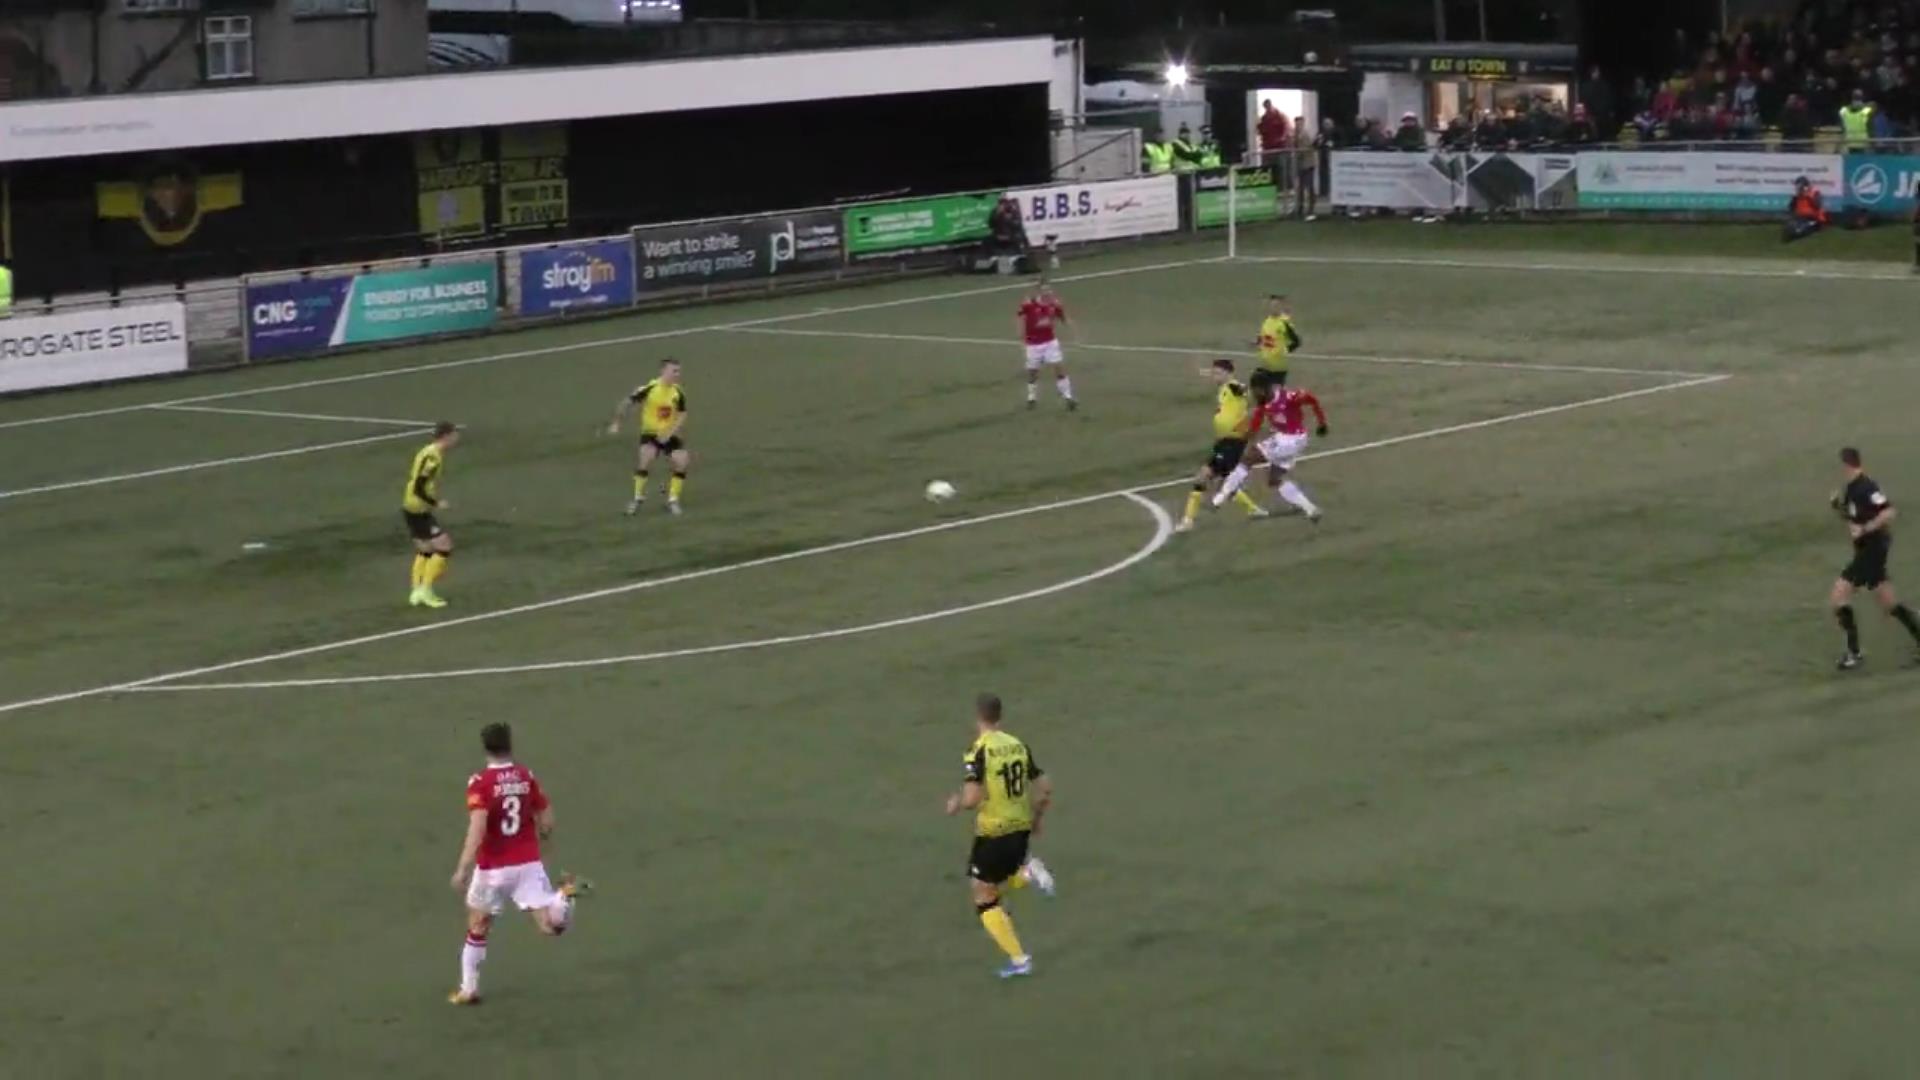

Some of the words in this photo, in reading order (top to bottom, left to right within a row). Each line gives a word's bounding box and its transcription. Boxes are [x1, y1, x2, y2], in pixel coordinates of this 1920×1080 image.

[1430, 59, 1453, 71] EAT
[1468, 59, 1507, 72] TOWN
[643, 239, 682, 258] Want
[684, 238, 701, 254] to
[703, 232, 740, 251] strike
[643, 265, 655, 279] a
[657, 256, 712, 277] winning
[715, 250, 756, 271] smile?
[253, 301, 297, 324] CNG
[109, 321, 180, 348] STEEL
[996, 760, 1024, 799] 18
[501, 796, 521, 836] 3
